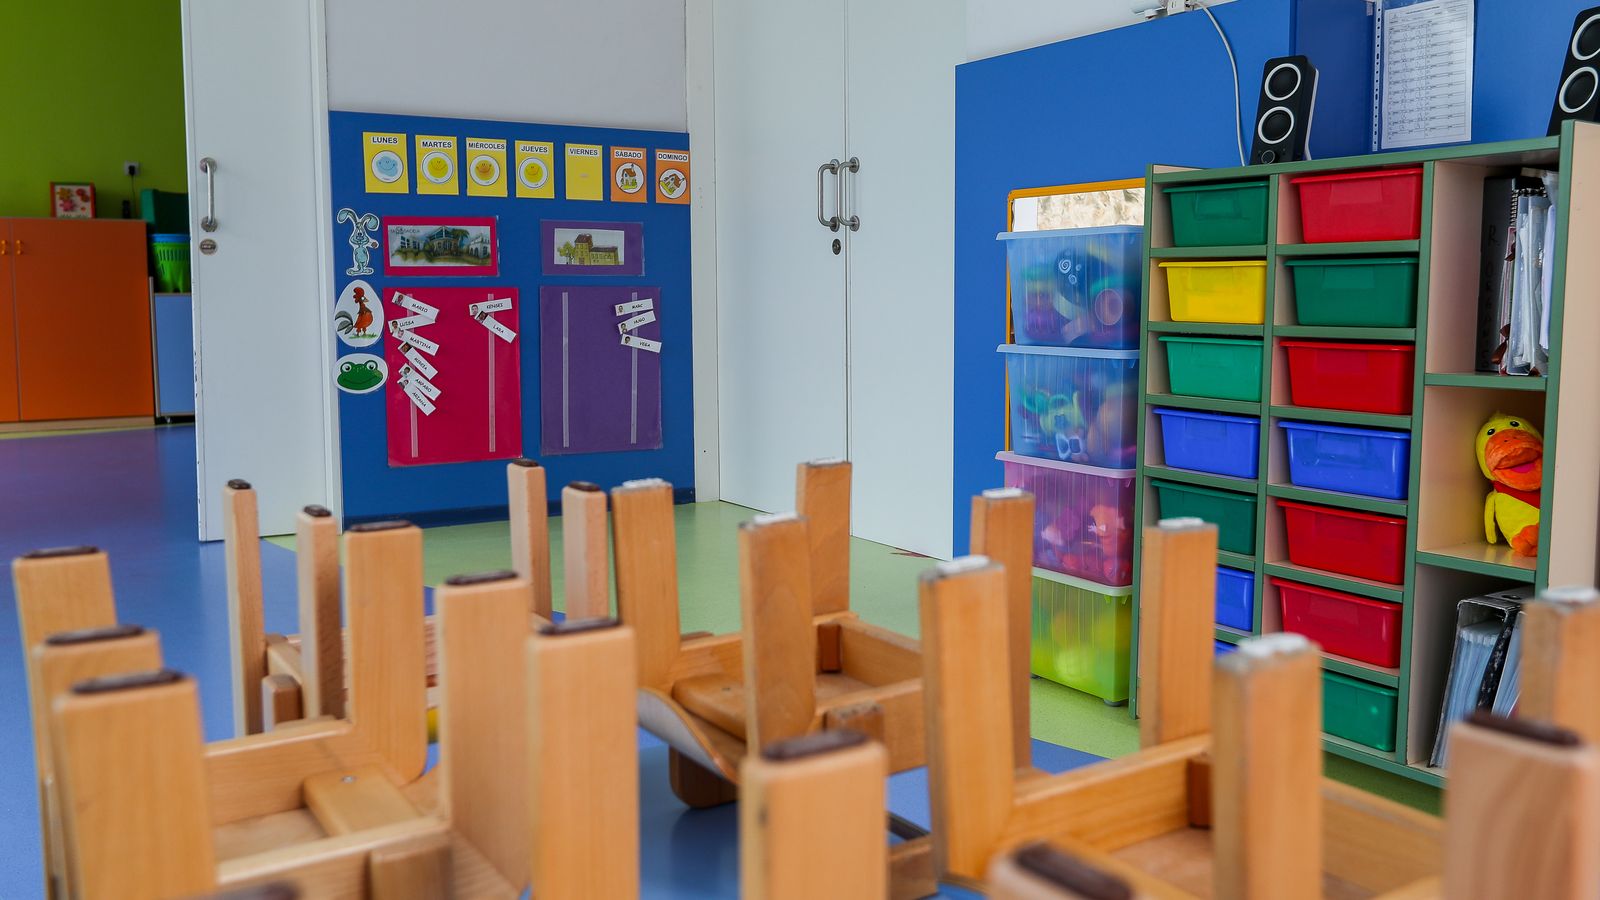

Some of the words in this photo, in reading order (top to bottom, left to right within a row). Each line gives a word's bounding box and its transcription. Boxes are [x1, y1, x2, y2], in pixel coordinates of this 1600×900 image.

[521, 145, 548, 153] JUEVES
[570, 148, 598, 156] VIERNES
[658, 153, 688, 161] DOMINGO
[412, 303, 428, 313] MARIO
[409, 336, 431, 350] MARTINA
[415, 378, 432, 393] AMPARO
